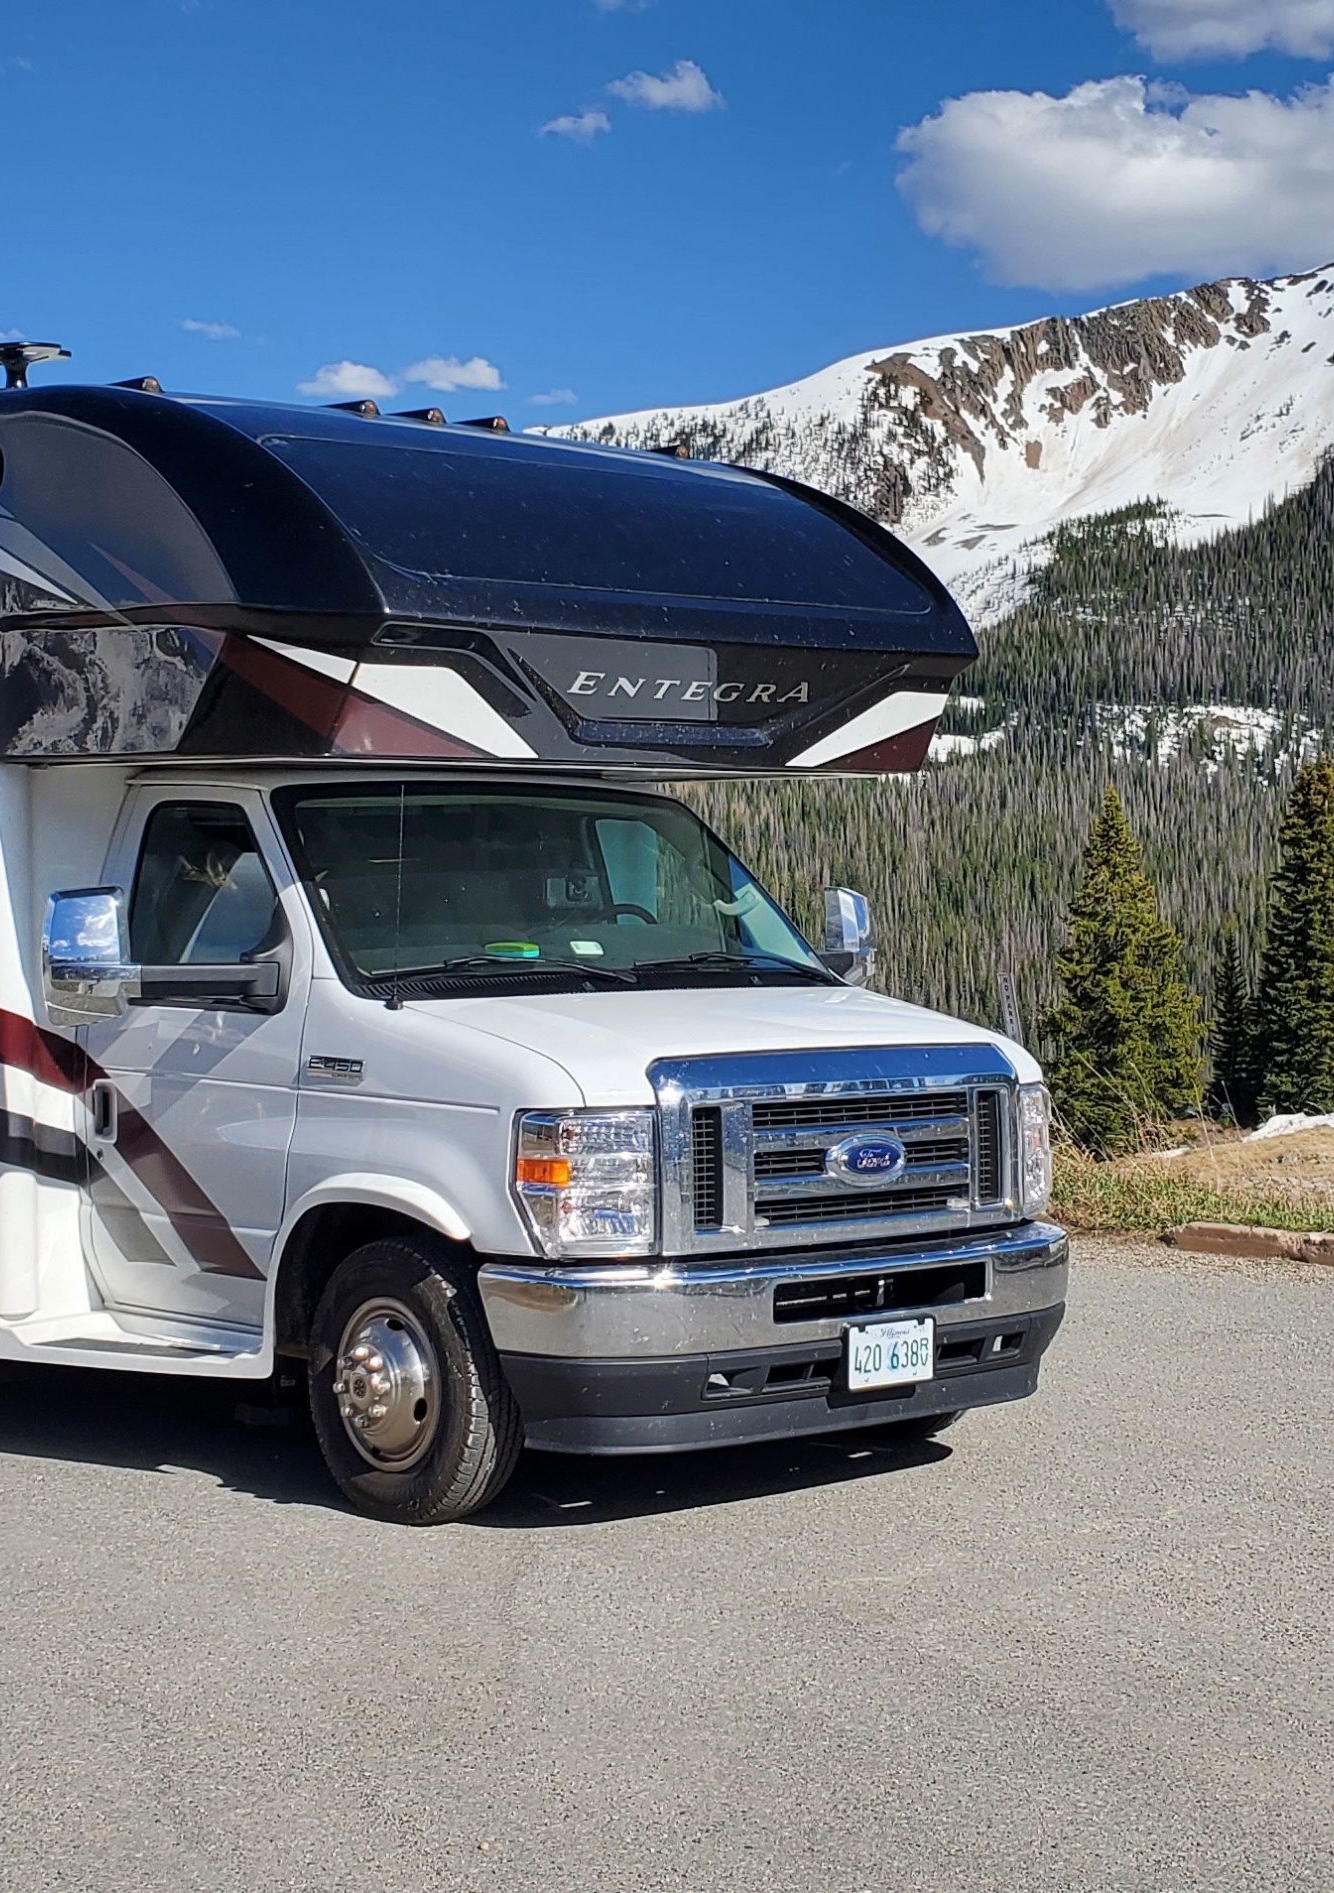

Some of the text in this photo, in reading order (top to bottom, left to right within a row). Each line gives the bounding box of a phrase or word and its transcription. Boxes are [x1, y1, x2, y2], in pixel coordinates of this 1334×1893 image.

[567, 670, 810, 703] ENTEGRA
[1005, 994, 1017, 1040] PARKIN
[857, 1148, 891, 1169] Ford
[854, 1343, 882, 1374] 420
[890, 1339, 919, 1370] 638
